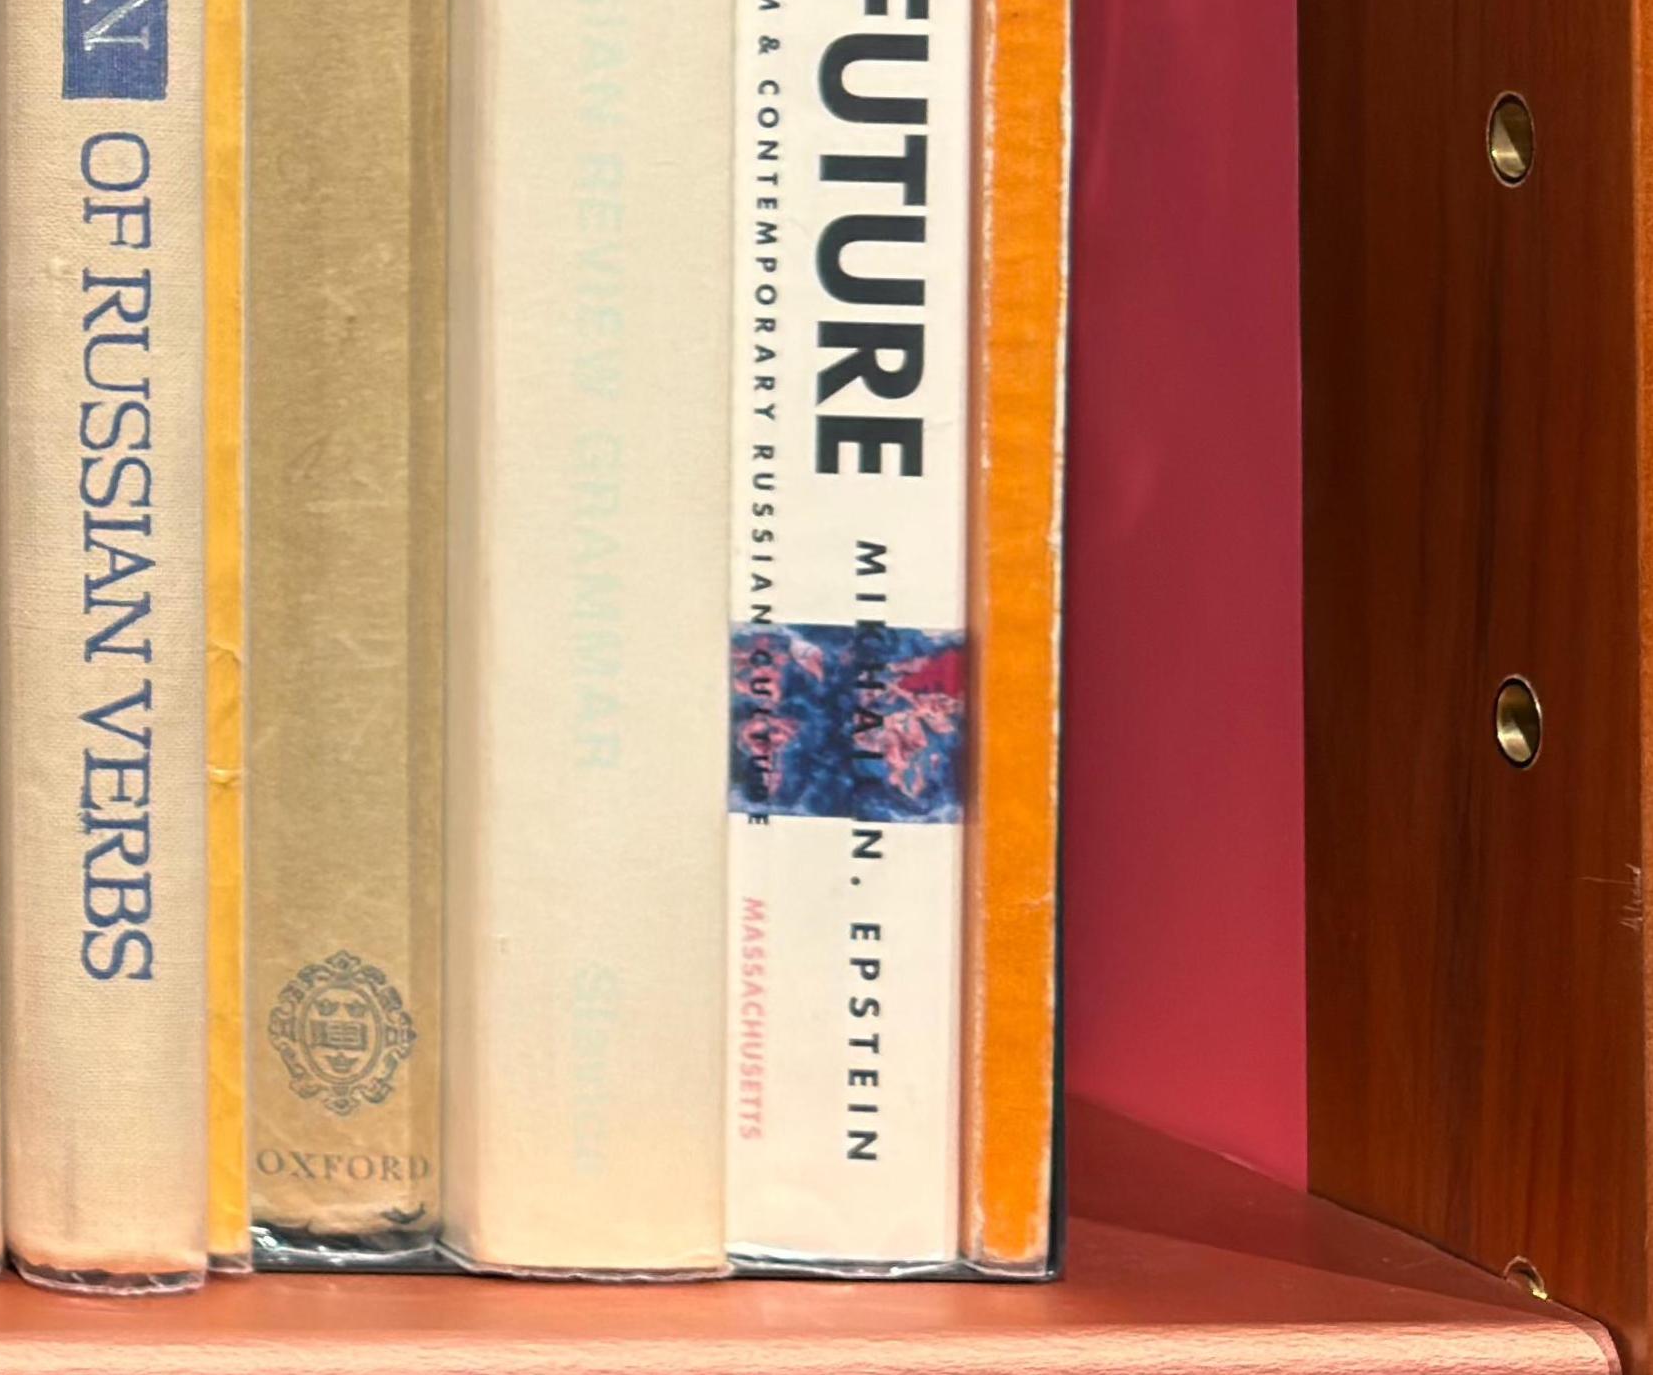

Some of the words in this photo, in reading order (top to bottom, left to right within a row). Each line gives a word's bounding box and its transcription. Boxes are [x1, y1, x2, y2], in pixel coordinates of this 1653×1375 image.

[756, 35, 783, 55] &
[79, 131, 152, 250] OF
[752, 79, 782, 421] CONTEMPORARY
[79, 267, 157, 663] RUSSIAN
[749, 444, 776, 626] RUSSIAN
[77, 680, 155, 981] VERBS
[851, 827, 884, 886] N.
[740, 895, 768, 1142] MASSACHUSETTS
[845, 922, 882, 1161] EPSTEIN
[255, 1148, 430, 1183] OXFORD
